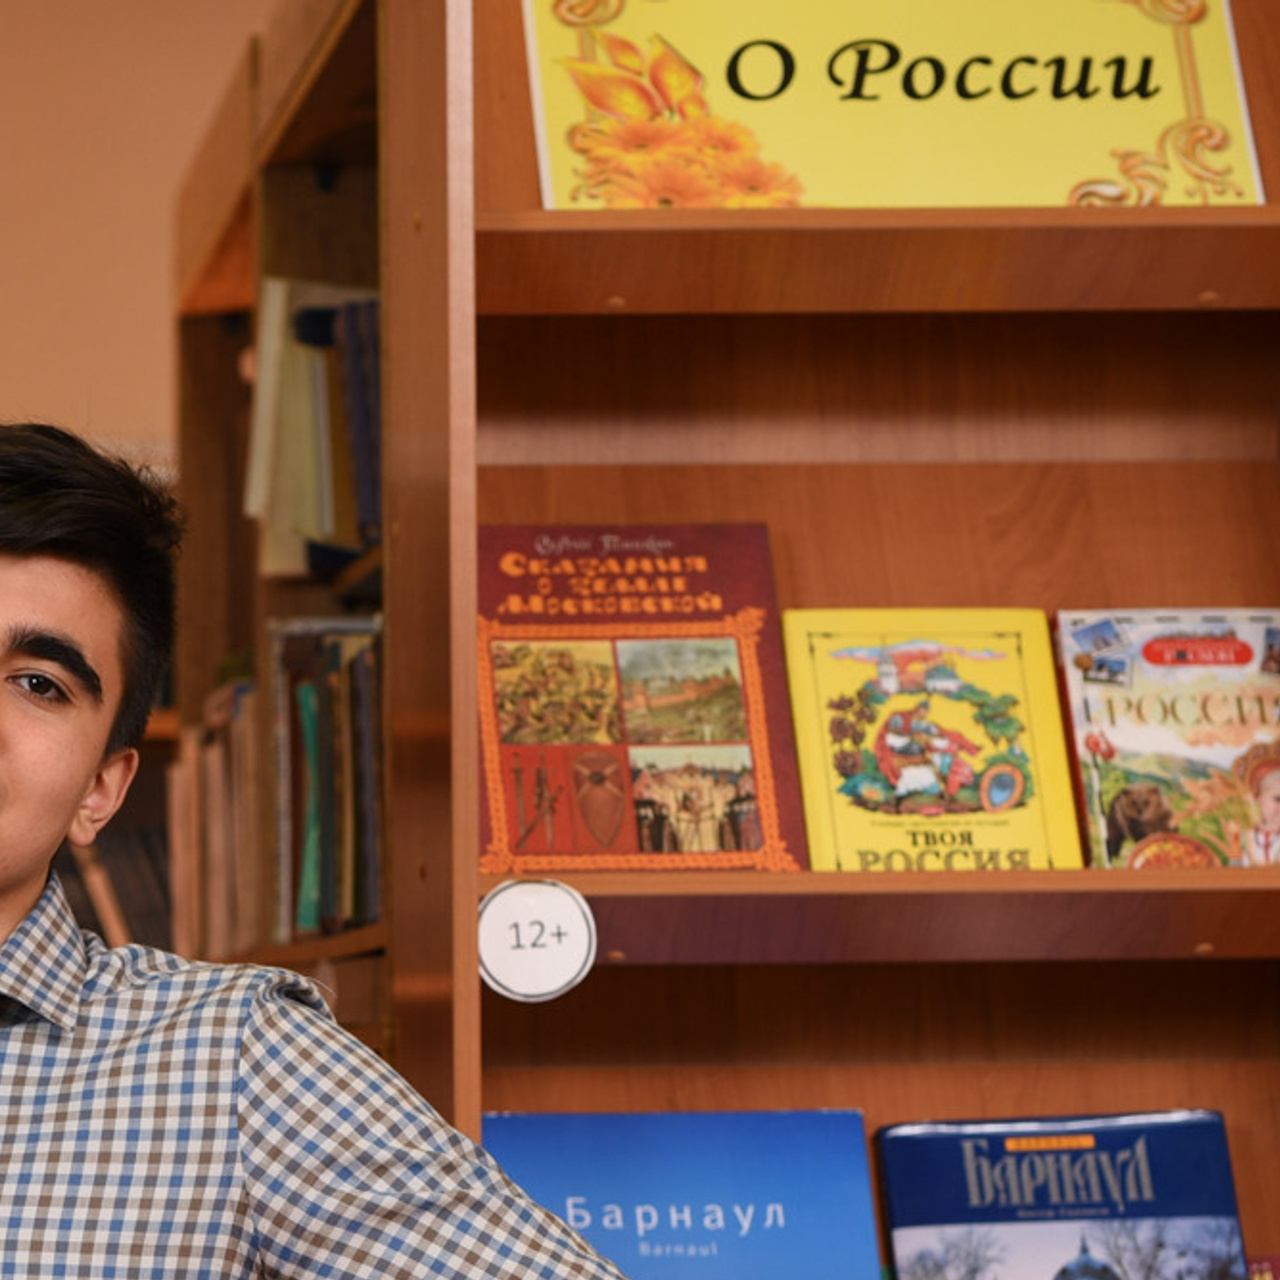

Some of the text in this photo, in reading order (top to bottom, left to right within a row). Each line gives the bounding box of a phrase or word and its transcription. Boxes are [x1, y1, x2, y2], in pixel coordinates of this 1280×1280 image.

[725, 38, 1162, 101] О России
[905, 829, 974, 847] ТВОЯ
[508, 919, 569, 951] 12+
[565, 1196, 786, 1237] Барнаул
